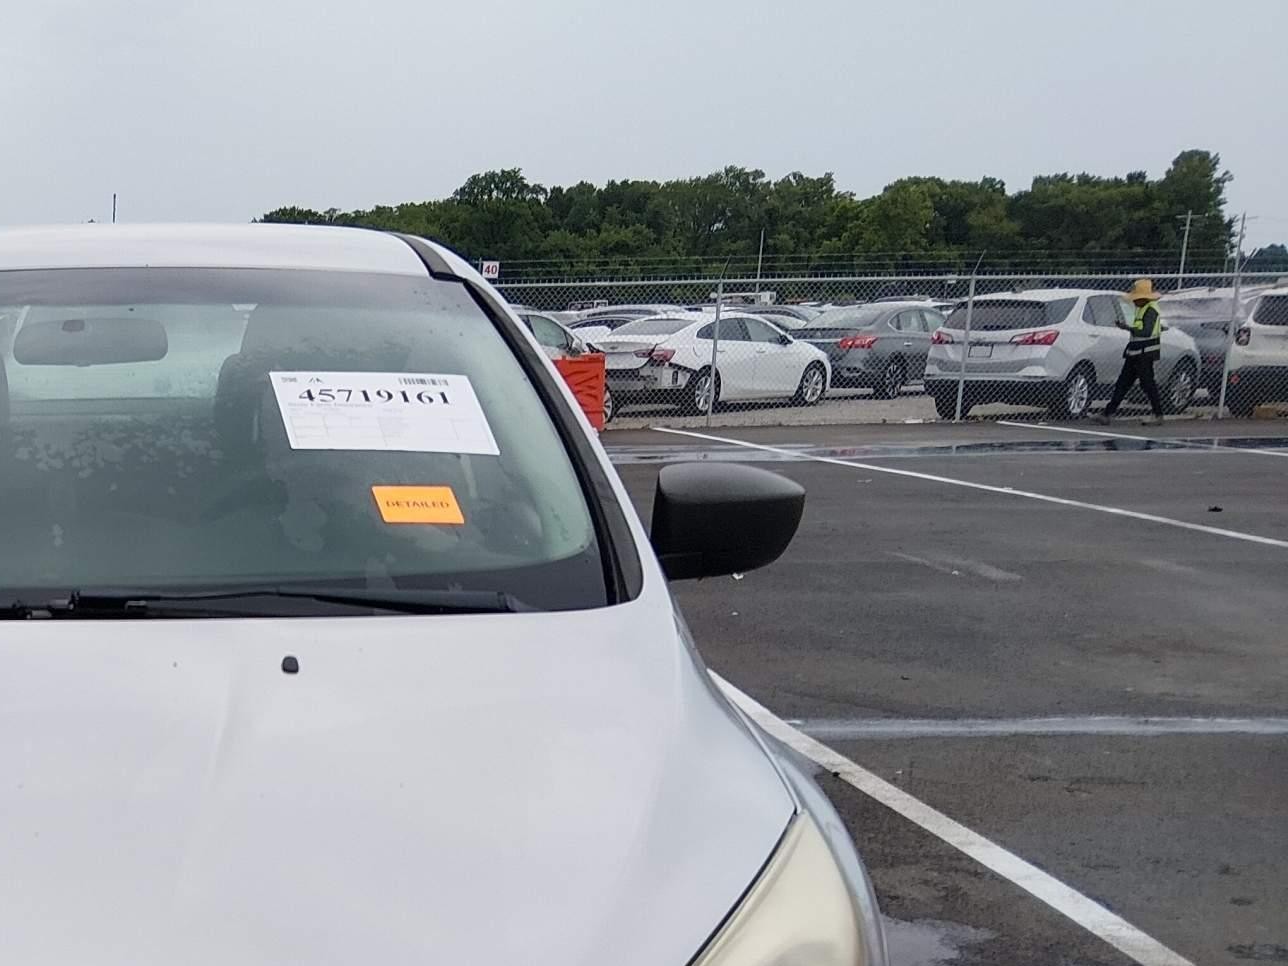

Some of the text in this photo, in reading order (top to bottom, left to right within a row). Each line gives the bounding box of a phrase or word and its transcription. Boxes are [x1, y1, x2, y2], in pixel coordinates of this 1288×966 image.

[484, 264, 498, 275] 40
[298, 388, 450, 405] 45719161
[385, 499, 450, 509] DETAILED
